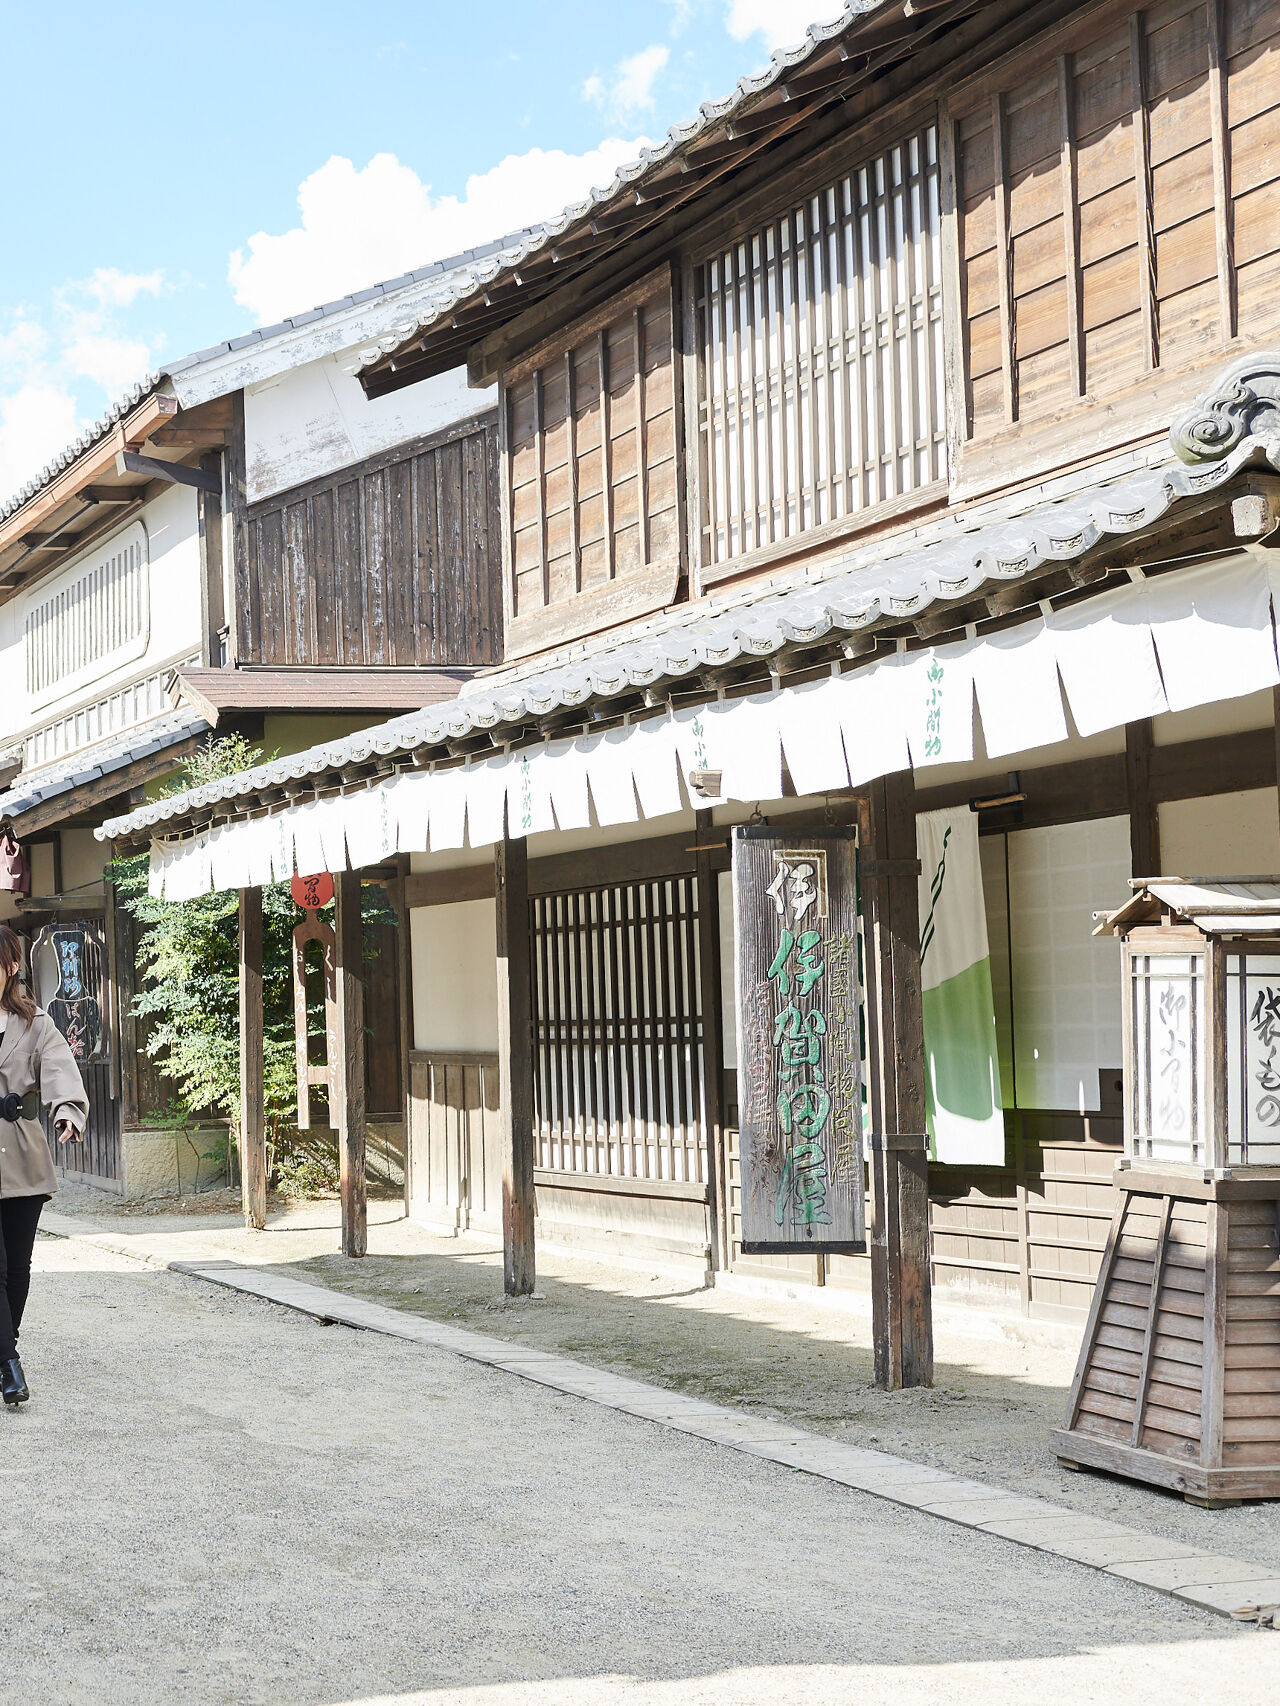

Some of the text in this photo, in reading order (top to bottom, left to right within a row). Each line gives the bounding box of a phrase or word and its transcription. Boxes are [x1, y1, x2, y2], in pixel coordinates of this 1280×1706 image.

[925, 658, 944, 757] 御小間物
[304, 873, 321, 906] 間物
